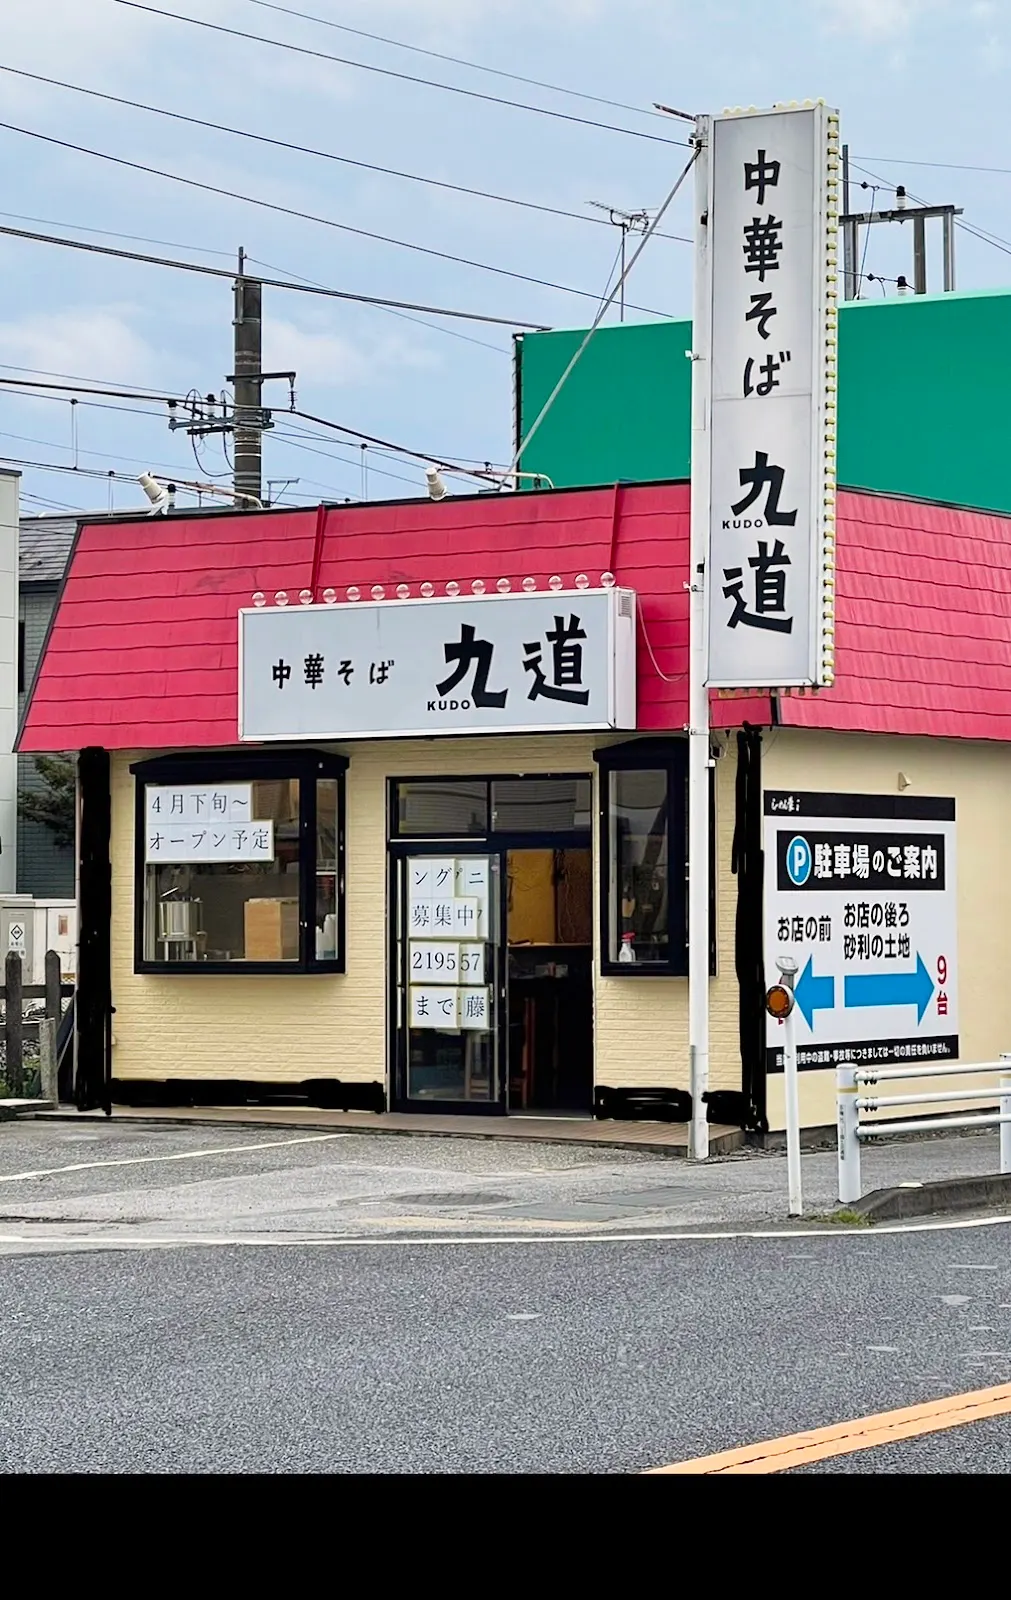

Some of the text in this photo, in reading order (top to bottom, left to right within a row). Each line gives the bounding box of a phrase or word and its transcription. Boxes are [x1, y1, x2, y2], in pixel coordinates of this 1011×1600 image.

[743, 149, 791, 398] 中華そば
[722, 519, 763, 530] KUDO
[721, 450, 798, 635] 九道
[272, 613, 590, 709] 中華そば 九道
[427, 699, 471, 712] KUDO
[150, 828, 269, 851] オープン予定
[793, 843, 938, 880] P 駐車場のご案内
[415, 867, 453, 888] ング
[412, 903, 474, 927] 募集中
[843, 901, 910, 929] お店の後ろ
[777, 915, 832, 943] お店の前
[843, 932, 911, 961] 砂利の土地
[412, 951, 456, 971] 2195
[415, 995, 454, 1016] まで
